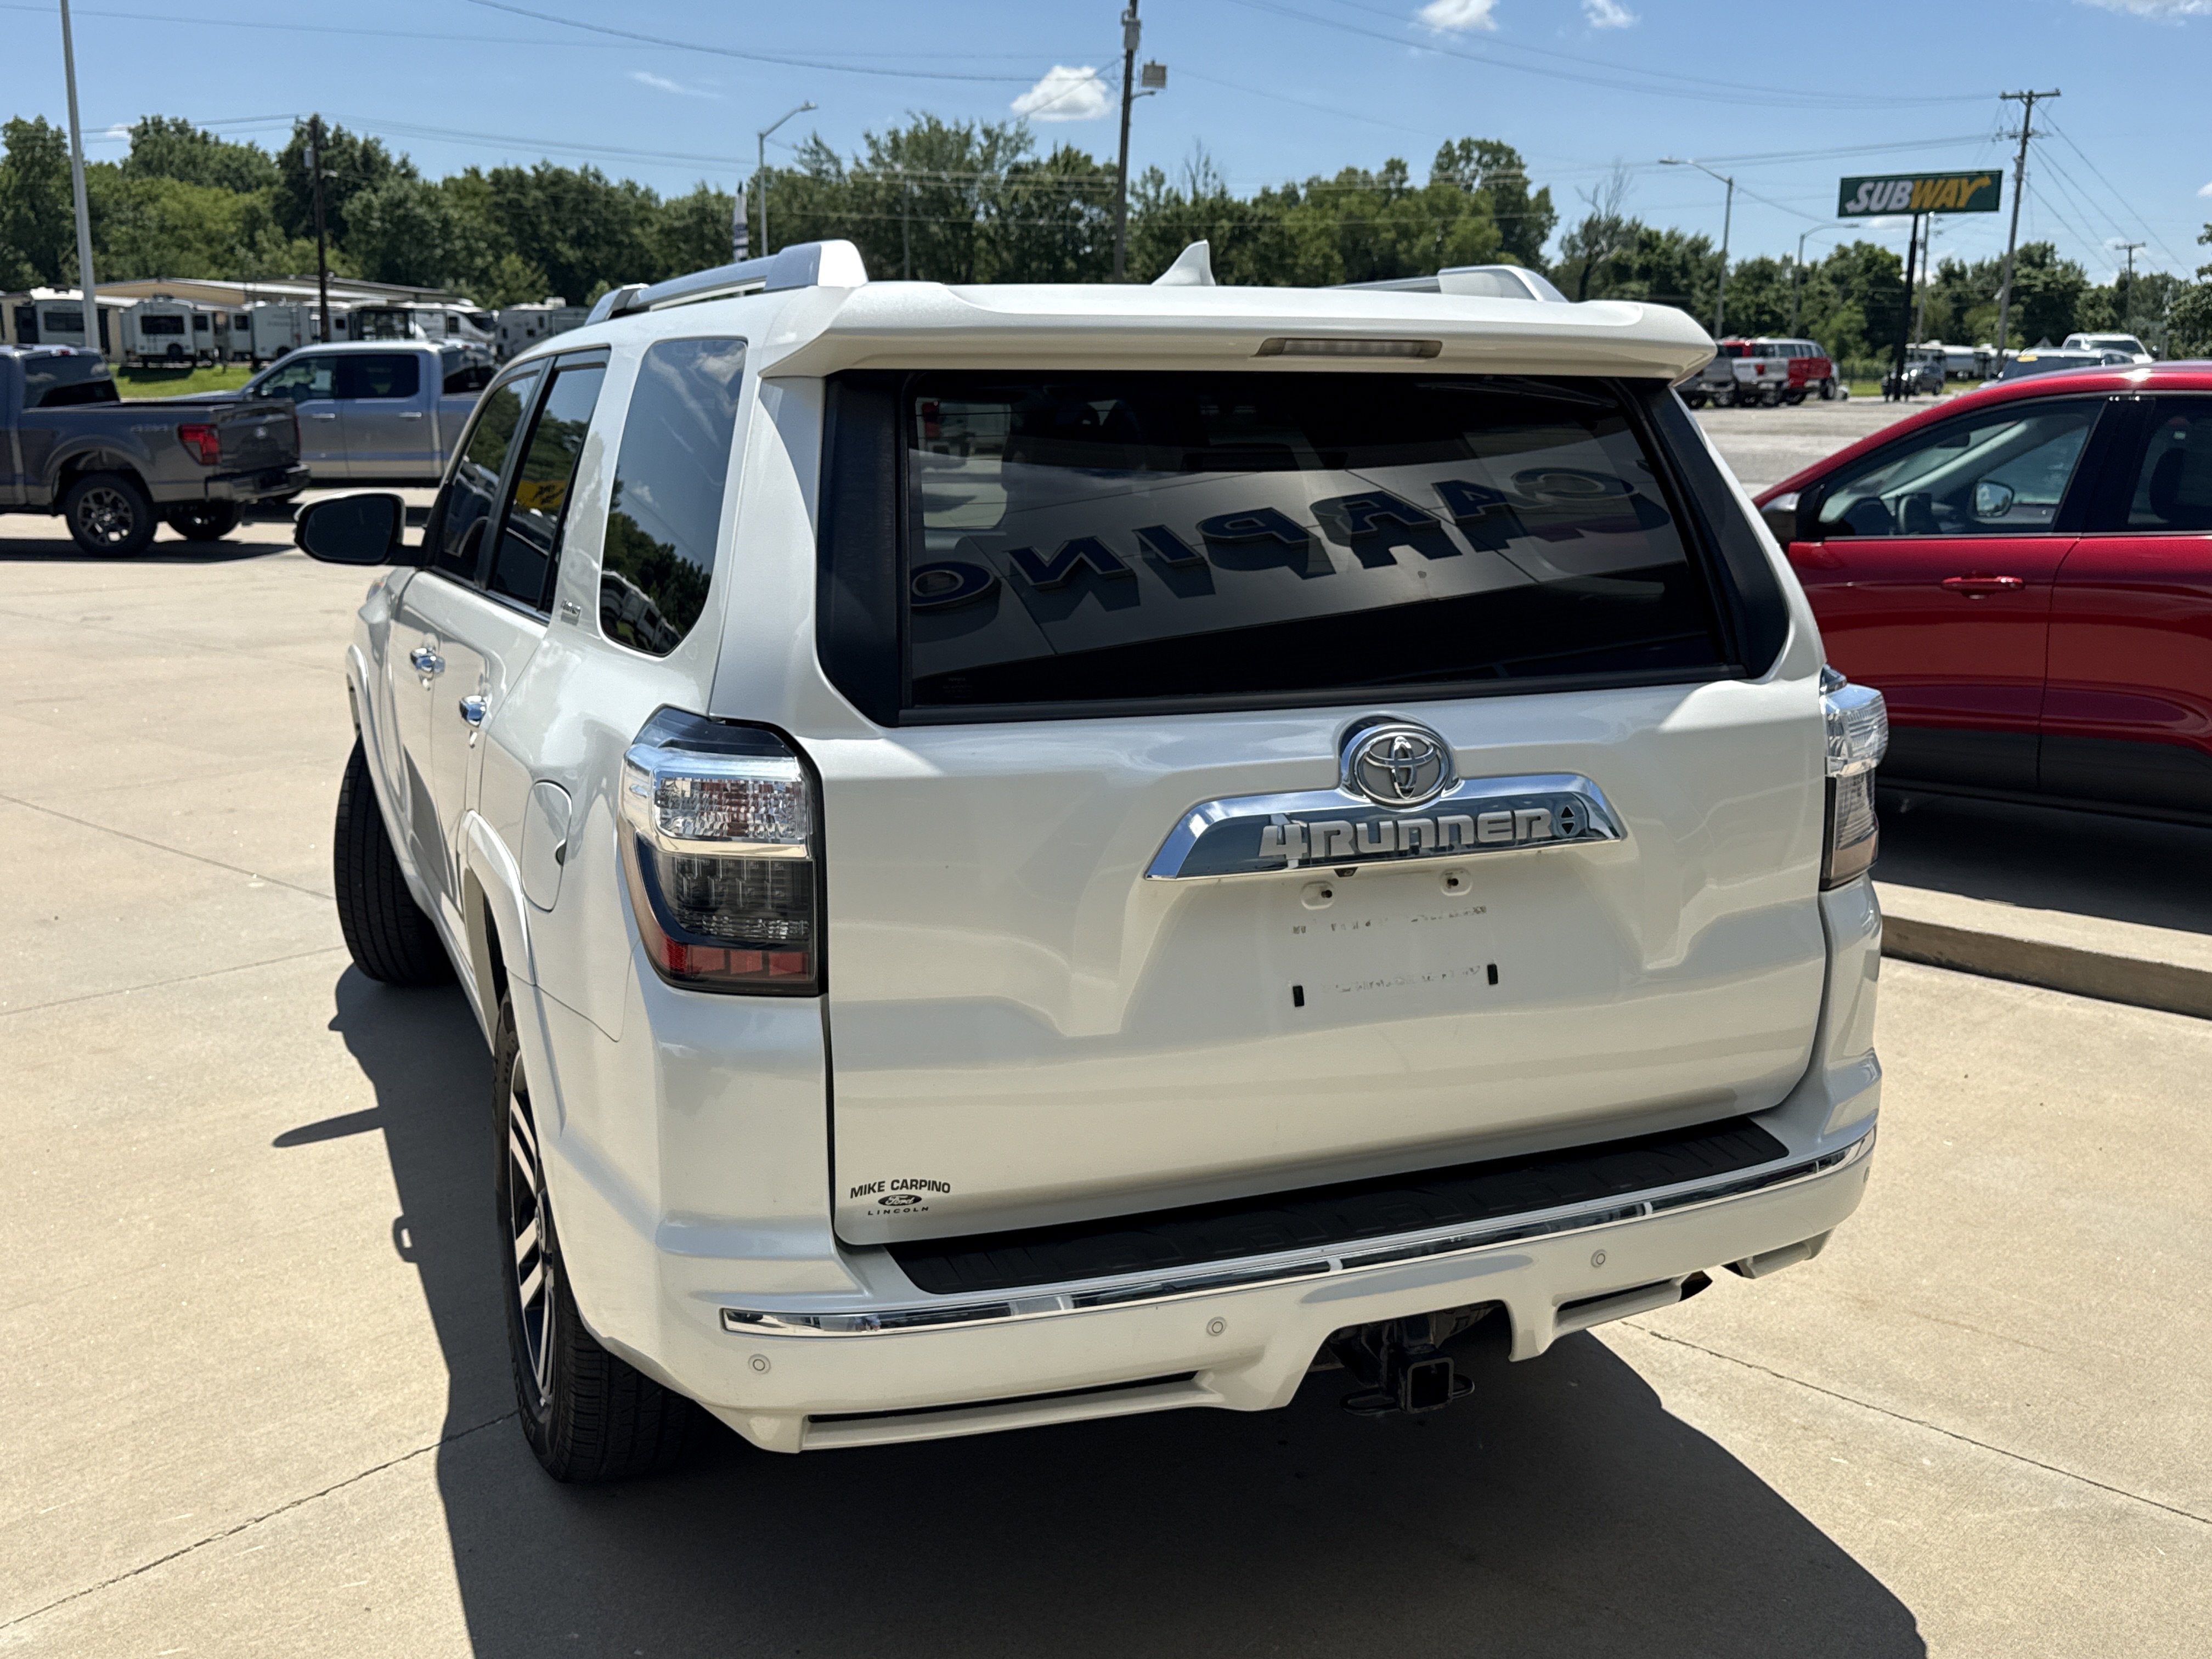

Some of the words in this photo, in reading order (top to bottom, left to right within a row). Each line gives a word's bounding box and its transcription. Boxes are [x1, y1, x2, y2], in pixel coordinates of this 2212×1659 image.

[1844, 176, 1991, 213] SUBWAY
[850, 1180, 886, 1199] MIKE
[890, 1178, 951, 1194] CARPINO
[884, 1195, 915, 1206] Ford
[867, 1206, 929, 1216] LINCOLN
